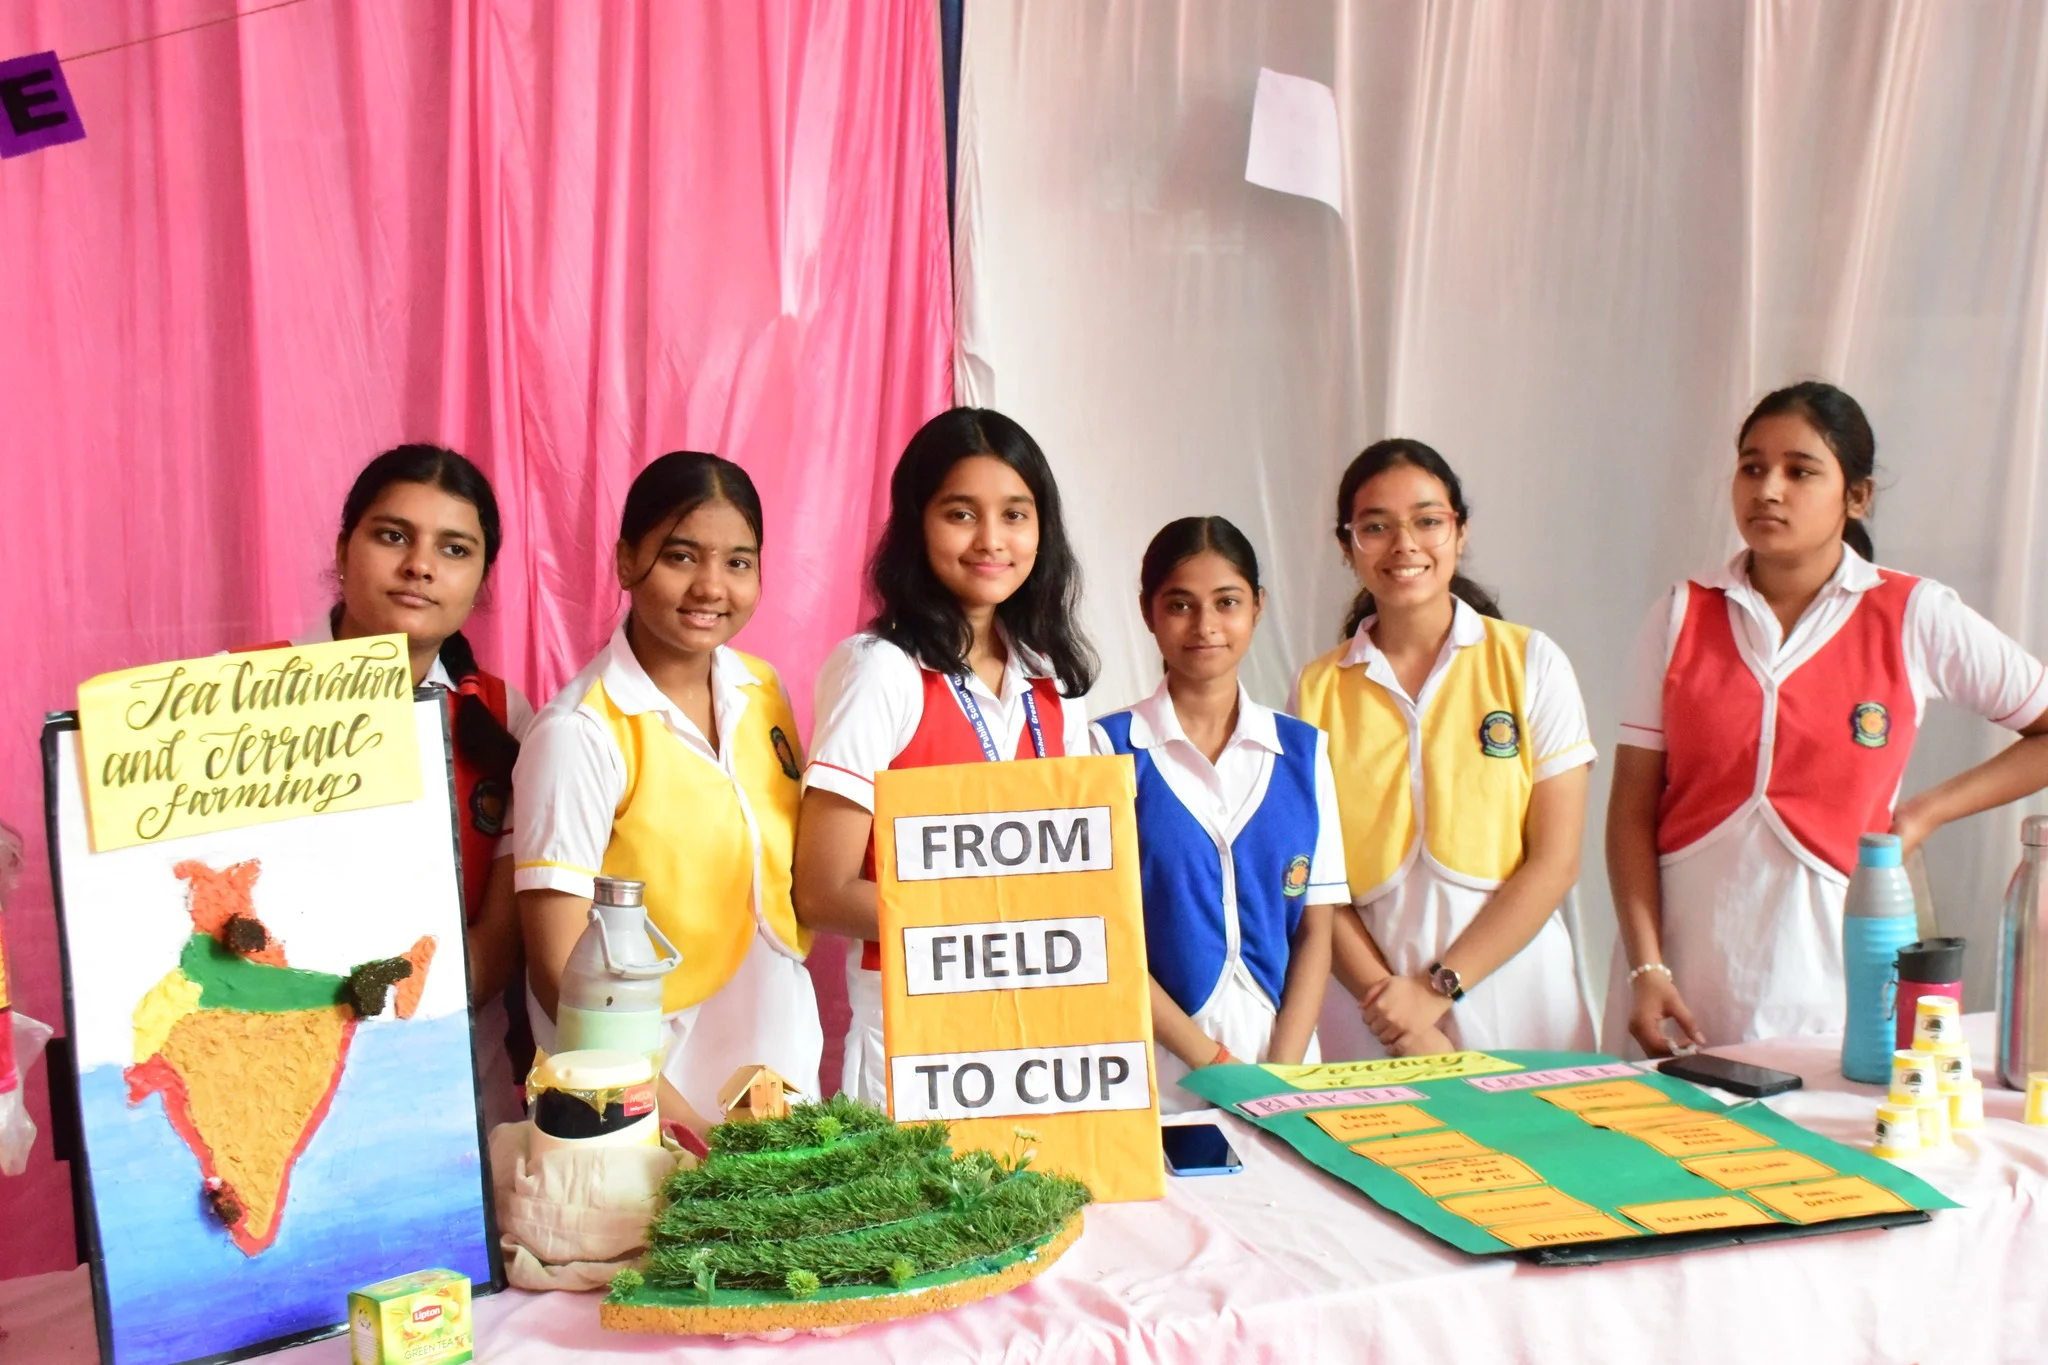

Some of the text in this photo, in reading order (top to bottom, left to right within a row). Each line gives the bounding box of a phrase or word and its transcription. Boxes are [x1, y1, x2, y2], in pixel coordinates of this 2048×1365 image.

[0, 68, 69, 136] E
[126, 641, 408, 731] Tea Cultivation
[959, 690, 979, 720] School
[102, 713, 382, 788] and Terrace
[976, 720, 992, 749] Public
[1027, 692, 1046, 758] School Greater
[922, 817, 1091, 870] FROM
[932, 930, 1082, 981] FIELD
[915, 1055, 1130, 1110] TO CUP
[1529, 1230, 1604, 1243] DRYING
[1656, 1211, 1728, 1224] DRYING
[414, 1307, 441, 1321] Lipton
[404, 1338, 454, 1361] GREEN TEA
